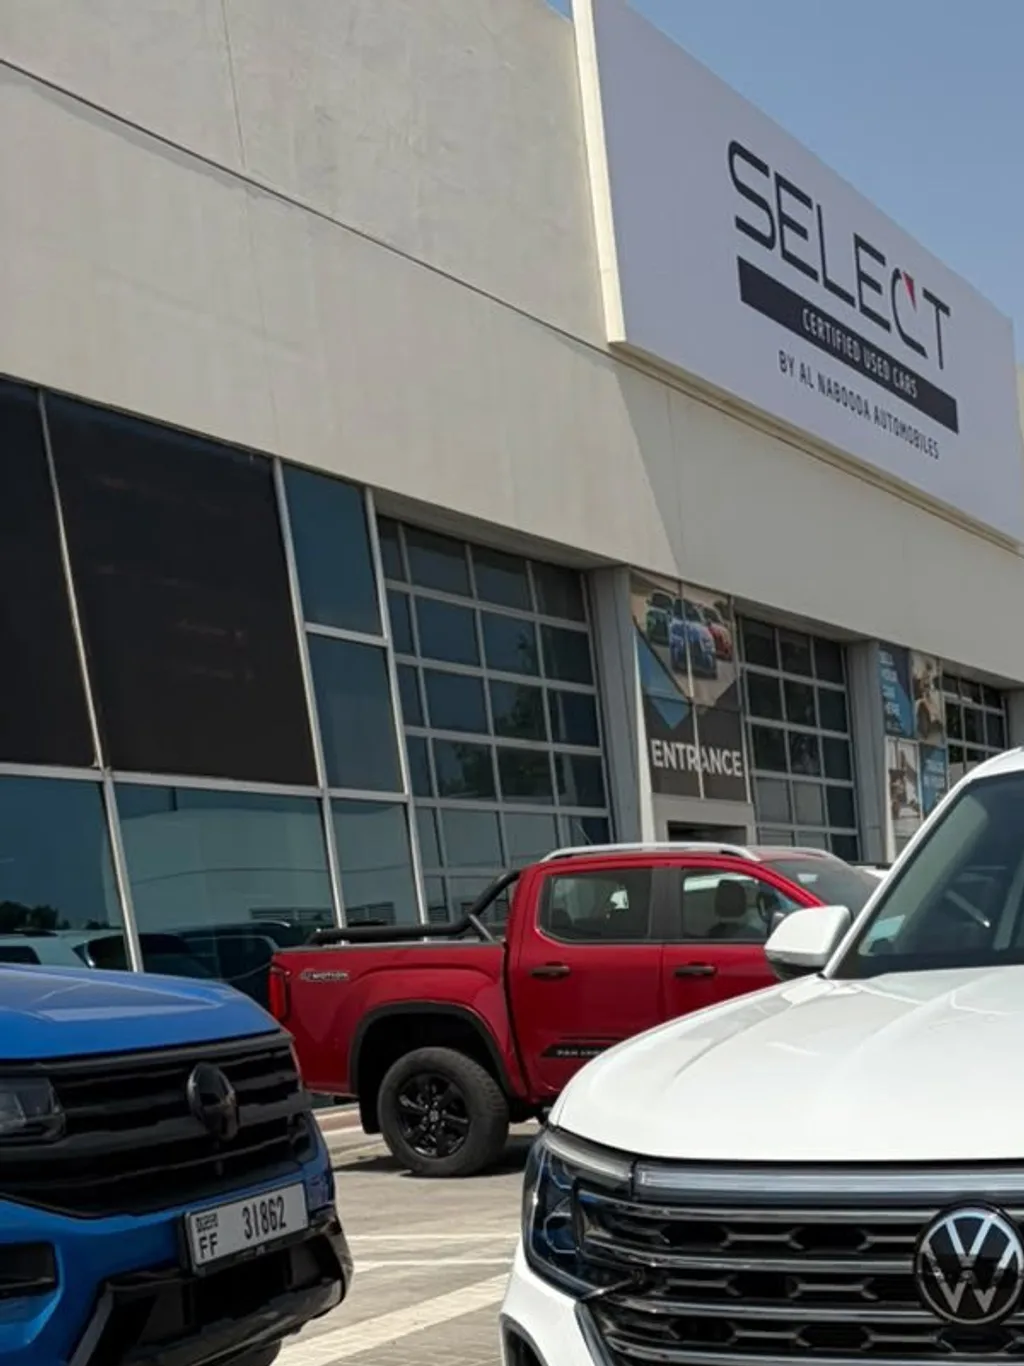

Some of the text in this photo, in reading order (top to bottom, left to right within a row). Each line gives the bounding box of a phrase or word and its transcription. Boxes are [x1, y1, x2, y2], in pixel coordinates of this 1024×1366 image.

[728, 139, 951, 370] SELECT
[803, 308, 918, 399] CERTIFIED USED CARS
[778, 350, 939, 460] BY AL NABOODA AUTOMOBILES
[652, 741, 743, 777] ENTRANCE
[199, 1232, 218, 1259] FF
[242, 1196, 287, 1240] 31862
